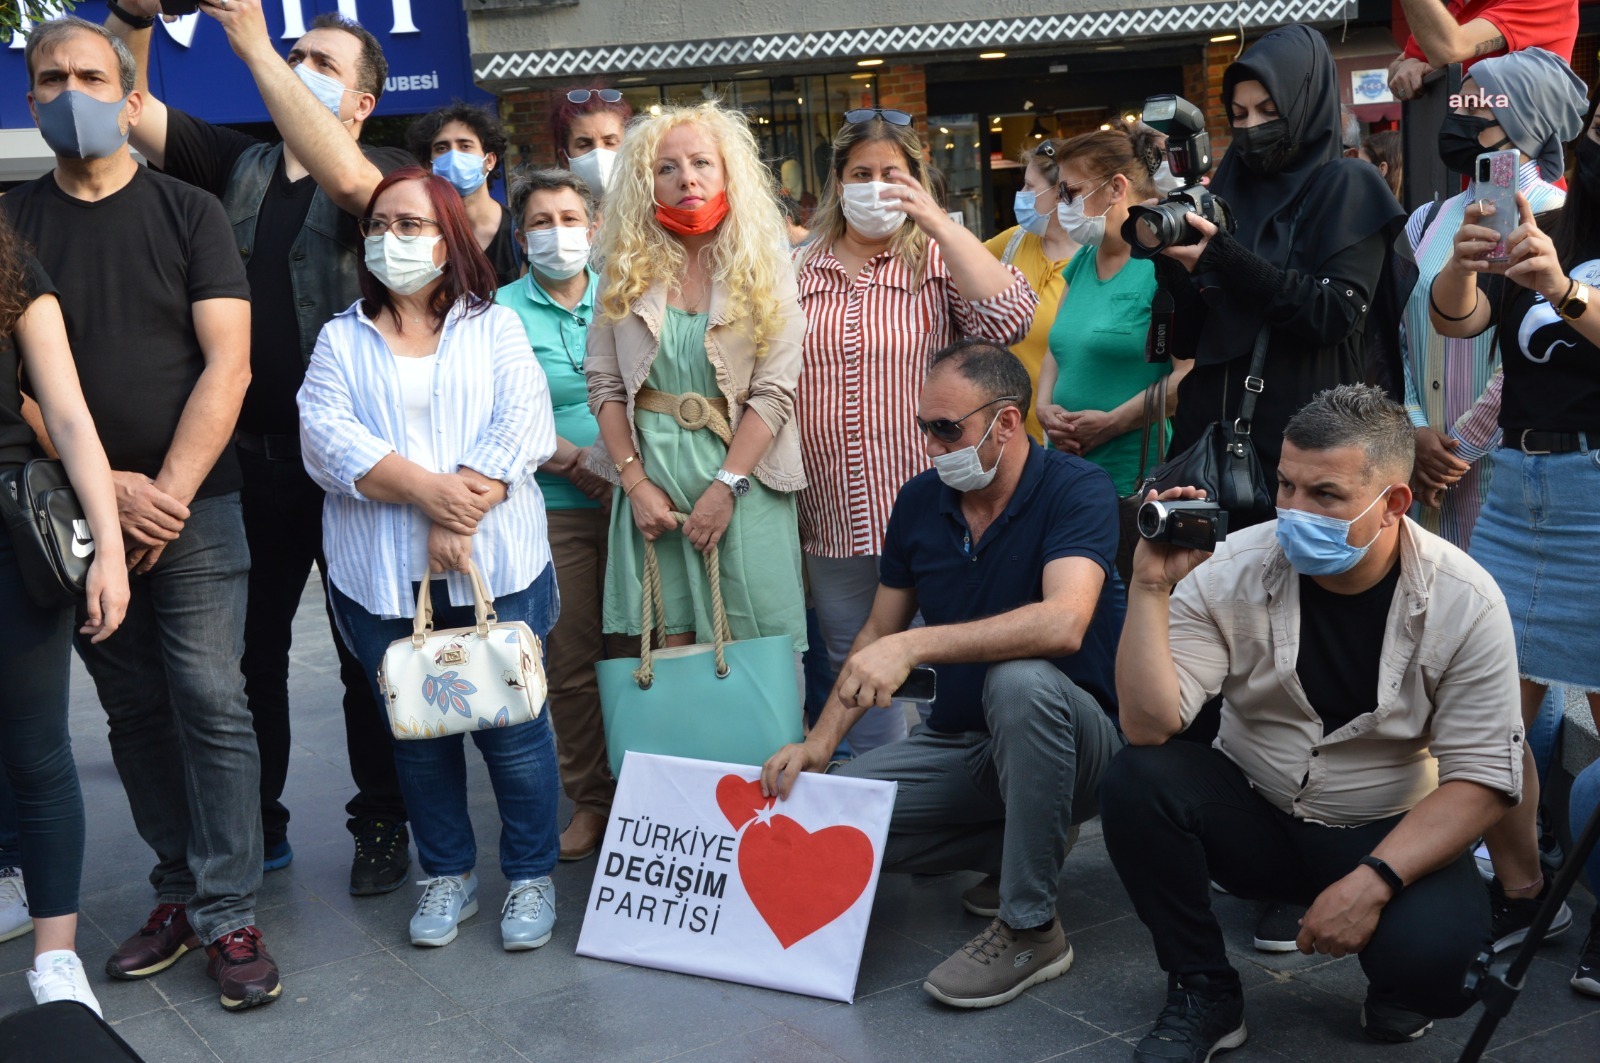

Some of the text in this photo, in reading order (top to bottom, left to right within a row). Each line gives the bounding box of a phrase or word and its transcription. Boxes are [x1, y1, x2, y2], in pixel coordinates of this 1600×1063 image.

[384, 70, 439, 92] UBESİ
[1155, 323, 1167, 355] Canon
[618, 815, 736, 863] TÜRKİYE
[604, 851, 728, 899] DEĞİŞİM
[595, 886, 721, 936] PARTİSİ
